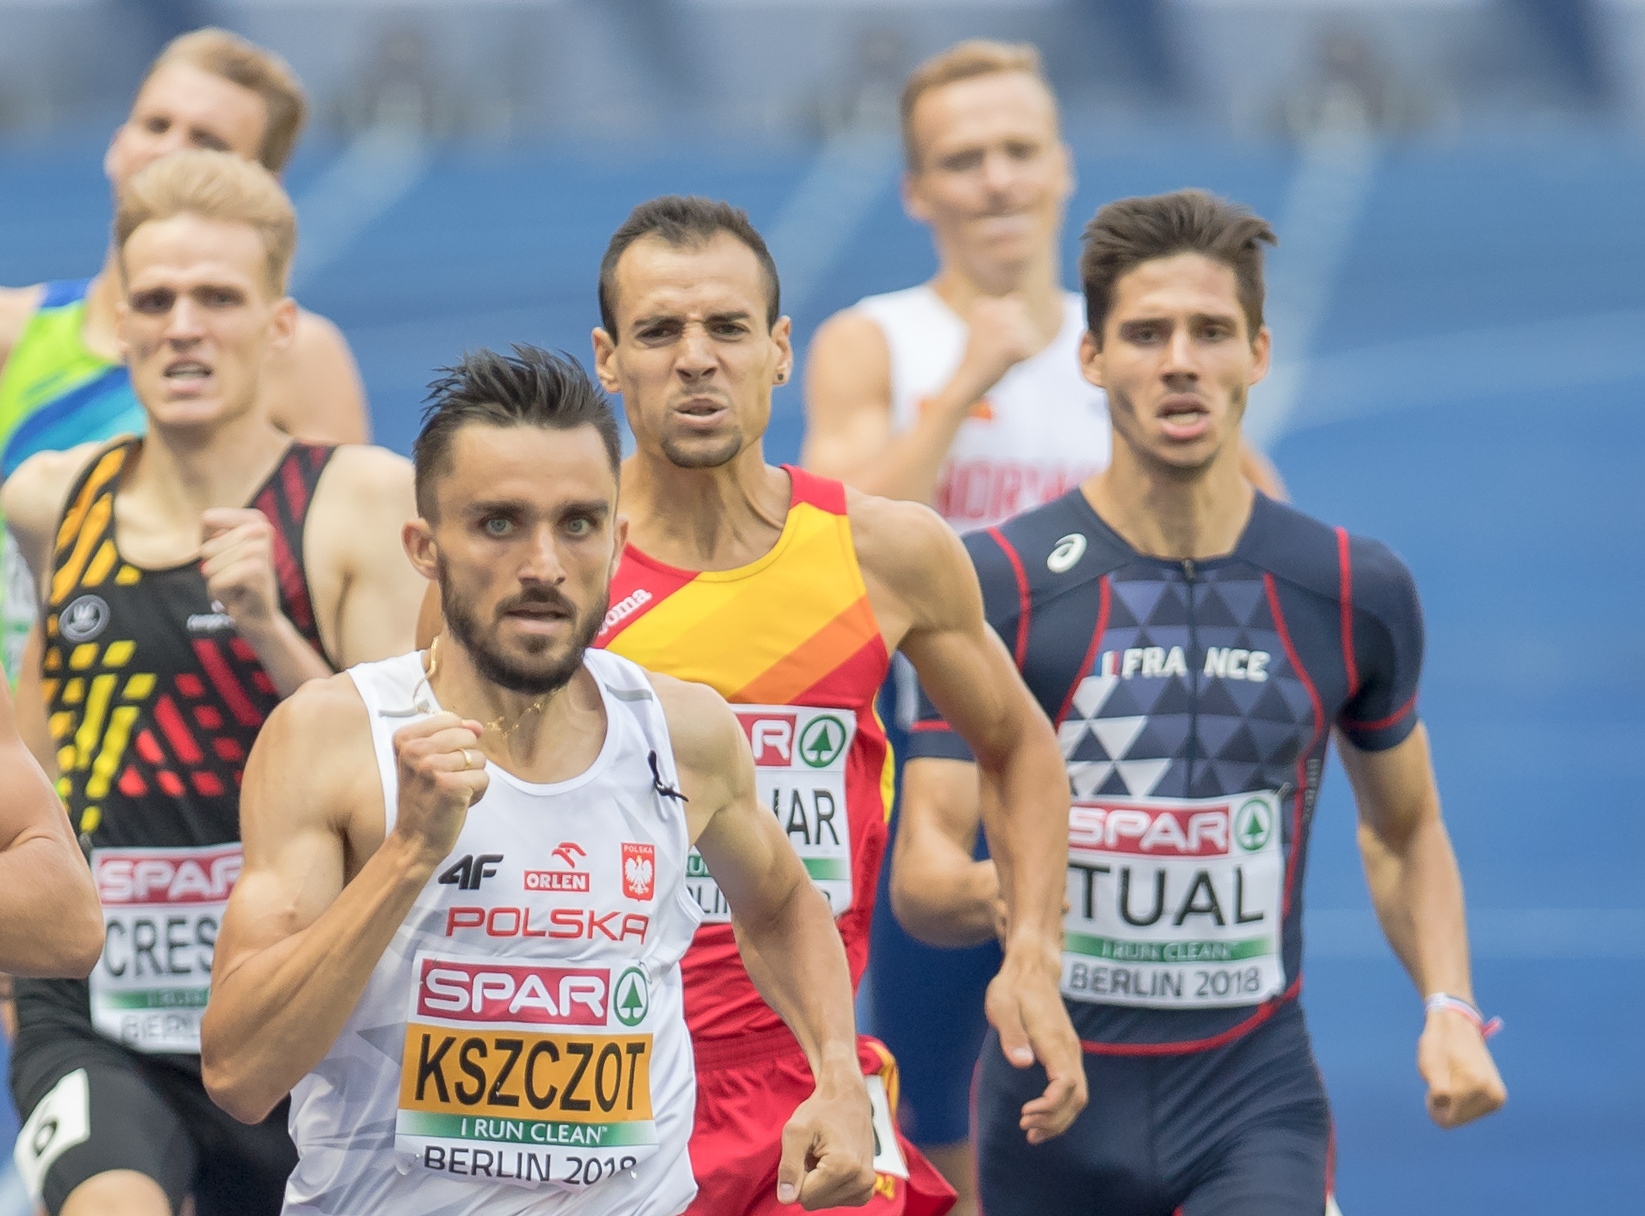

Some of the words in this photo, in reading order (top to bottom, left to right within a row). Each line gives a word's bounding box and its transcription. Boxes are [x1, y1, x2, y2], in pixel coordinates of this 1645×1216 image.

[1067, 805, 1228, 853] SPAR
[438, 854, 505, 890] 4F
[526, 872, 587, 890] ORLEN
[1068, 863, 1264, 927] TUAL
[445, 906, 650, 945] POLSKA
[104, 916, 218, 978] CRES
[423, 967, 605, 1019] SPAR
[1069, 961, 1183, 997] BERLIN
[1194, 965, 1261, 997] 2018
[414, 1032, 647, 1114] KSZCZOT
[460, 1117, 467, 1136] I
[474, 1118, 524, 1141] RUN
[423, 1144, 552, 1183] BERLIN
